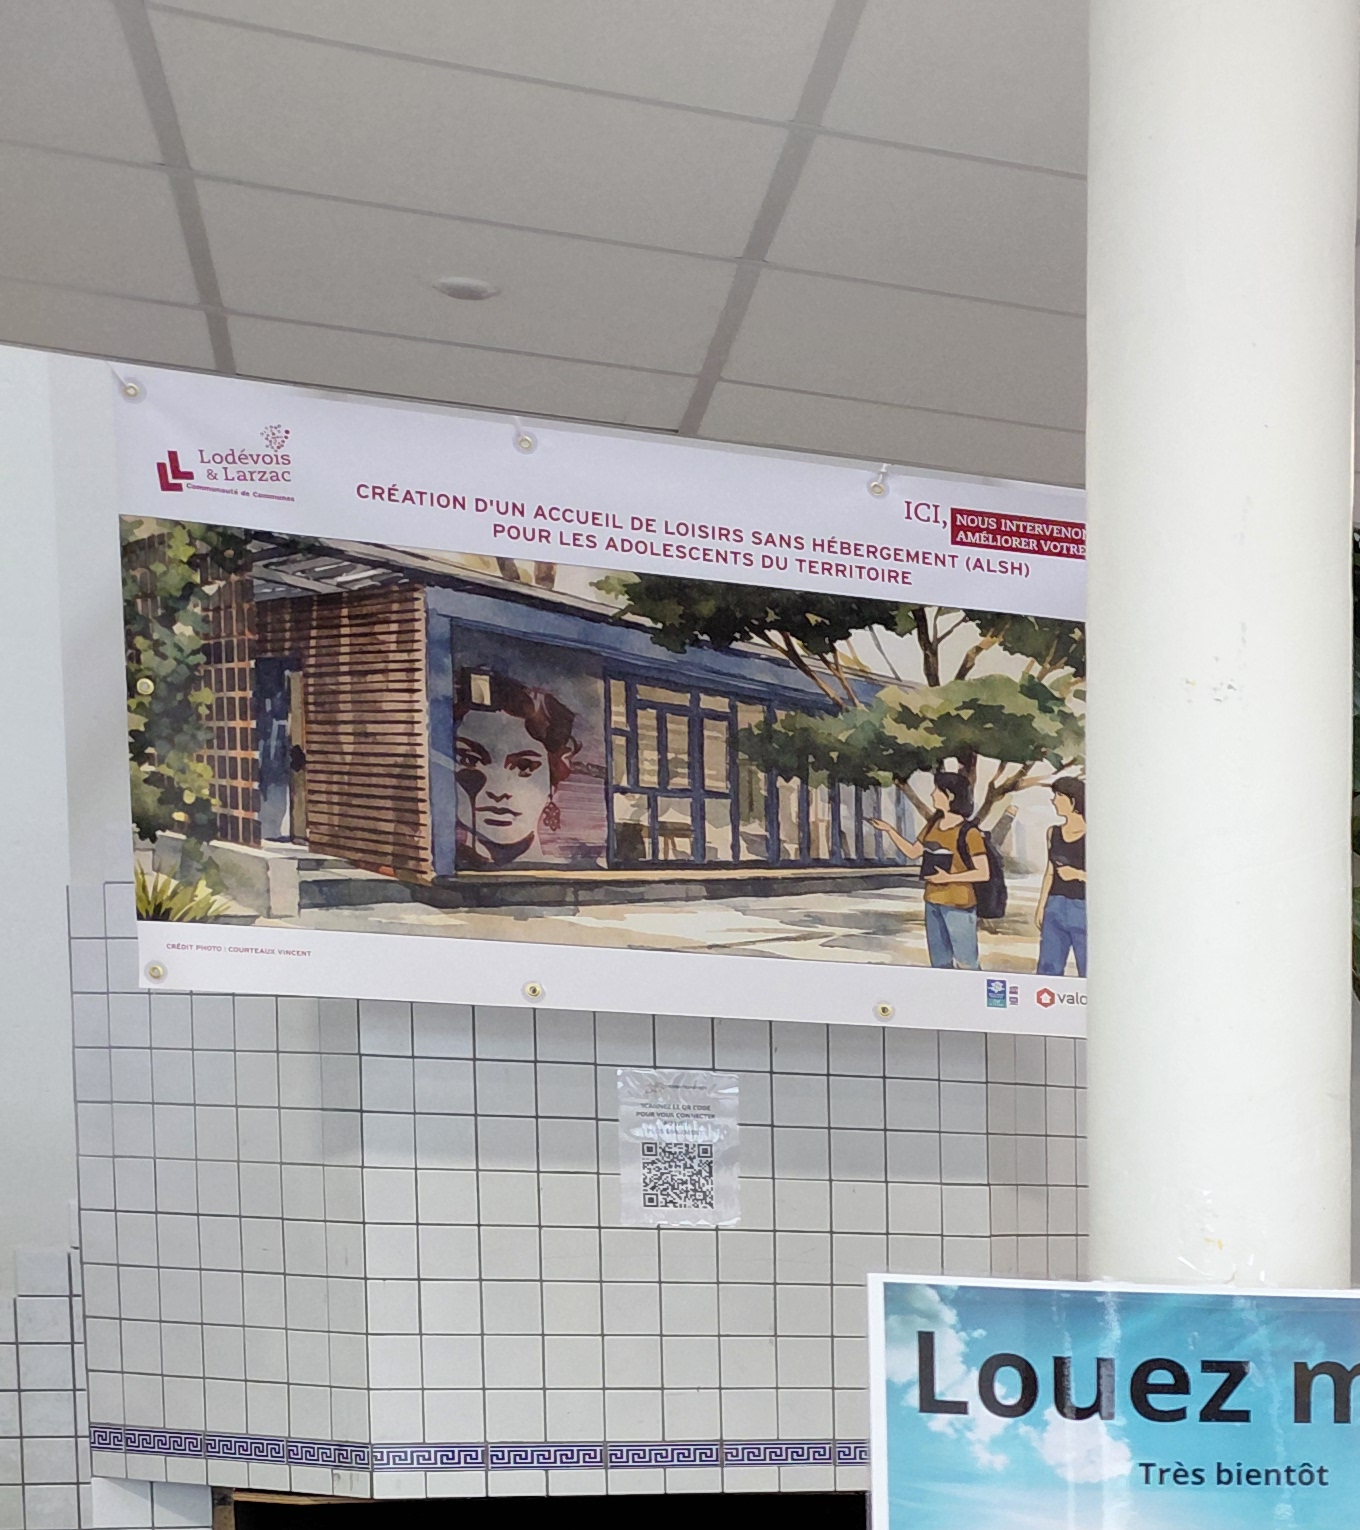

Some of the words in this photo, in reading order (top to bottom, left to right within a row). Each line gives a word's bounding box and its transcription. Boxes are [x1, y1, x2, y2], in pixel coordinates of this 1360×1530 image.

[198, 449, 292, 466] Lodévois
[206, 468, 219, 480] &
[222, 467, 292, 482] Larzac
[186, 483, 239, 495] Communauté
[252, 491, 295, 502] Communes
[904, 501, 948, 529] ICI,
[955, 513, 997, 529] NOUS
[356, 483, 466, 511] CRÉATION
[474, 497, 525, 518] D'UN
[533, 505, 624, 530] ACCUEIL
[631, 516, 657, 533] DE
[664, 520, 744, 543] LOISIRS
[751, 531, 805, 550] SANS
[812, 535, 959, 568] HÉBERGEMENT
[965, 556, 1030, 578] (ALSH)
[955, 530, 1038, 551] AMÉLIORER
[1040, 541, 1086, 556] VOTRE
[492, 523, 551, 543] POUR
[559, 531, 597, 549] LES
[605, 537, 754, 567] ADOLESCENTS
[761, 555, 788, 570] DU
[795, 558, 912, 585] TERRITOIRE
[196, 944, 222, 952] PHOTO
[228, 946, 275, 955] COURTEAUX
[277, 949, 311, 957] VINCENT
[916, 1330, 1252, 1423] Louez
[1138, 1461, 1205, 1488] Très
[1216, 1460, 1329, 1489] bientôt
